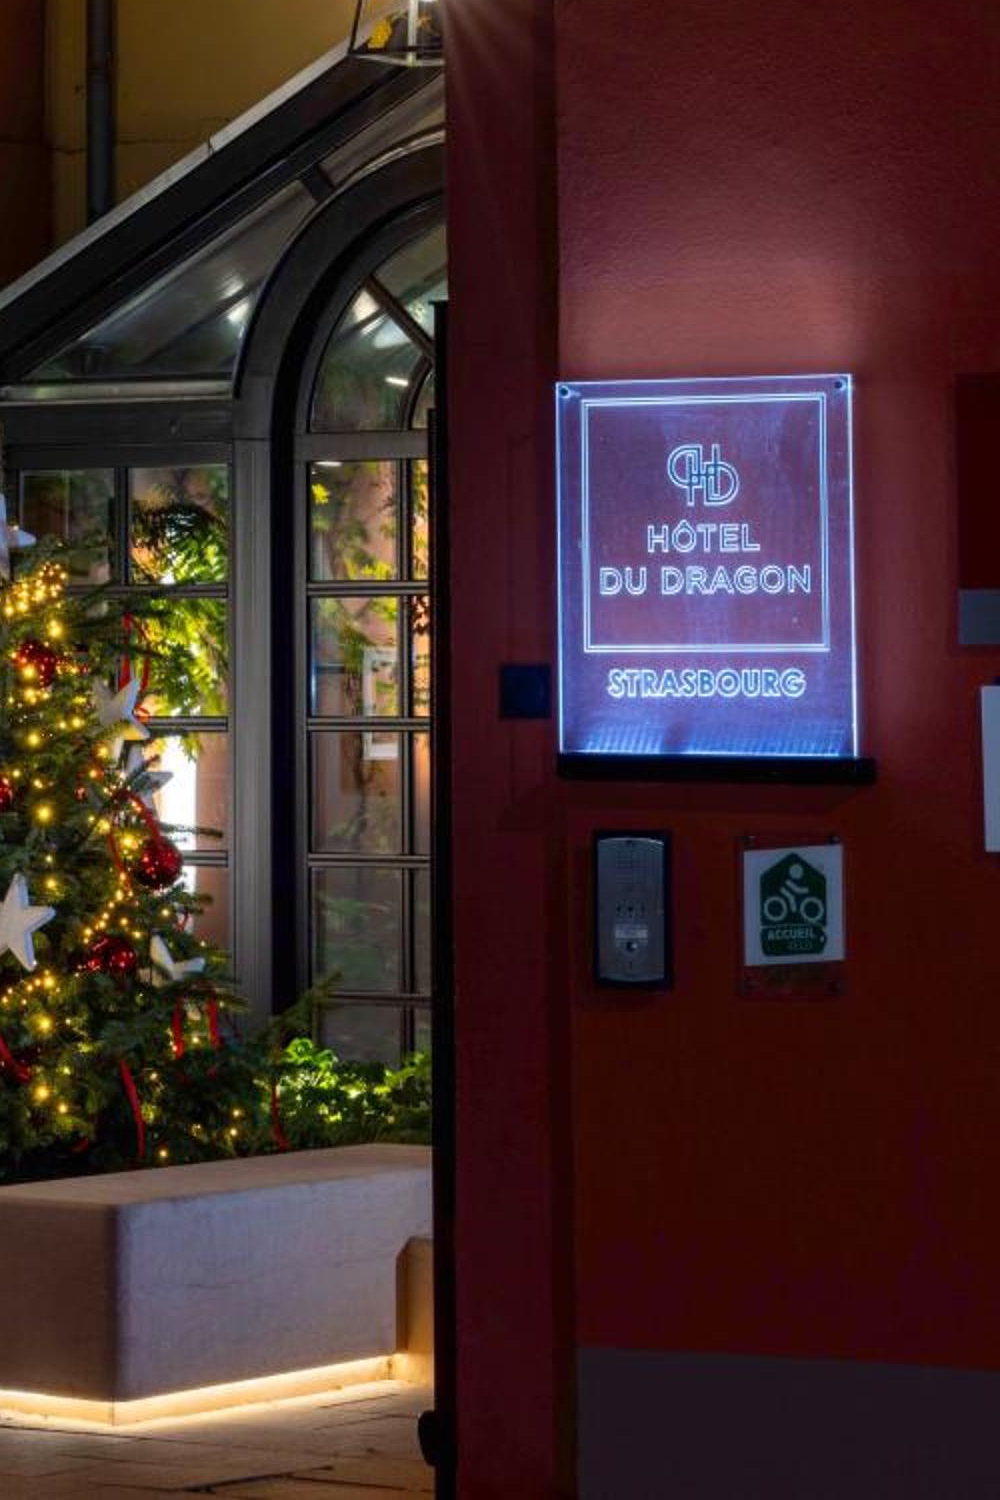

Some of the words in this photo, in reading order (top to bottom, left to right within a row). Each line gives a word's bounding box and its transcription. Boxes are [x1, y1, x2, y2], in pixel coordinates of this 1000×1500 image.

[647, 520, 760, 553] HÔTEL
[600, 567, 648, 596] DU
[661, 565, 812, 595] DRAGON
[607, 668, 807, 698] STRASBOURG
